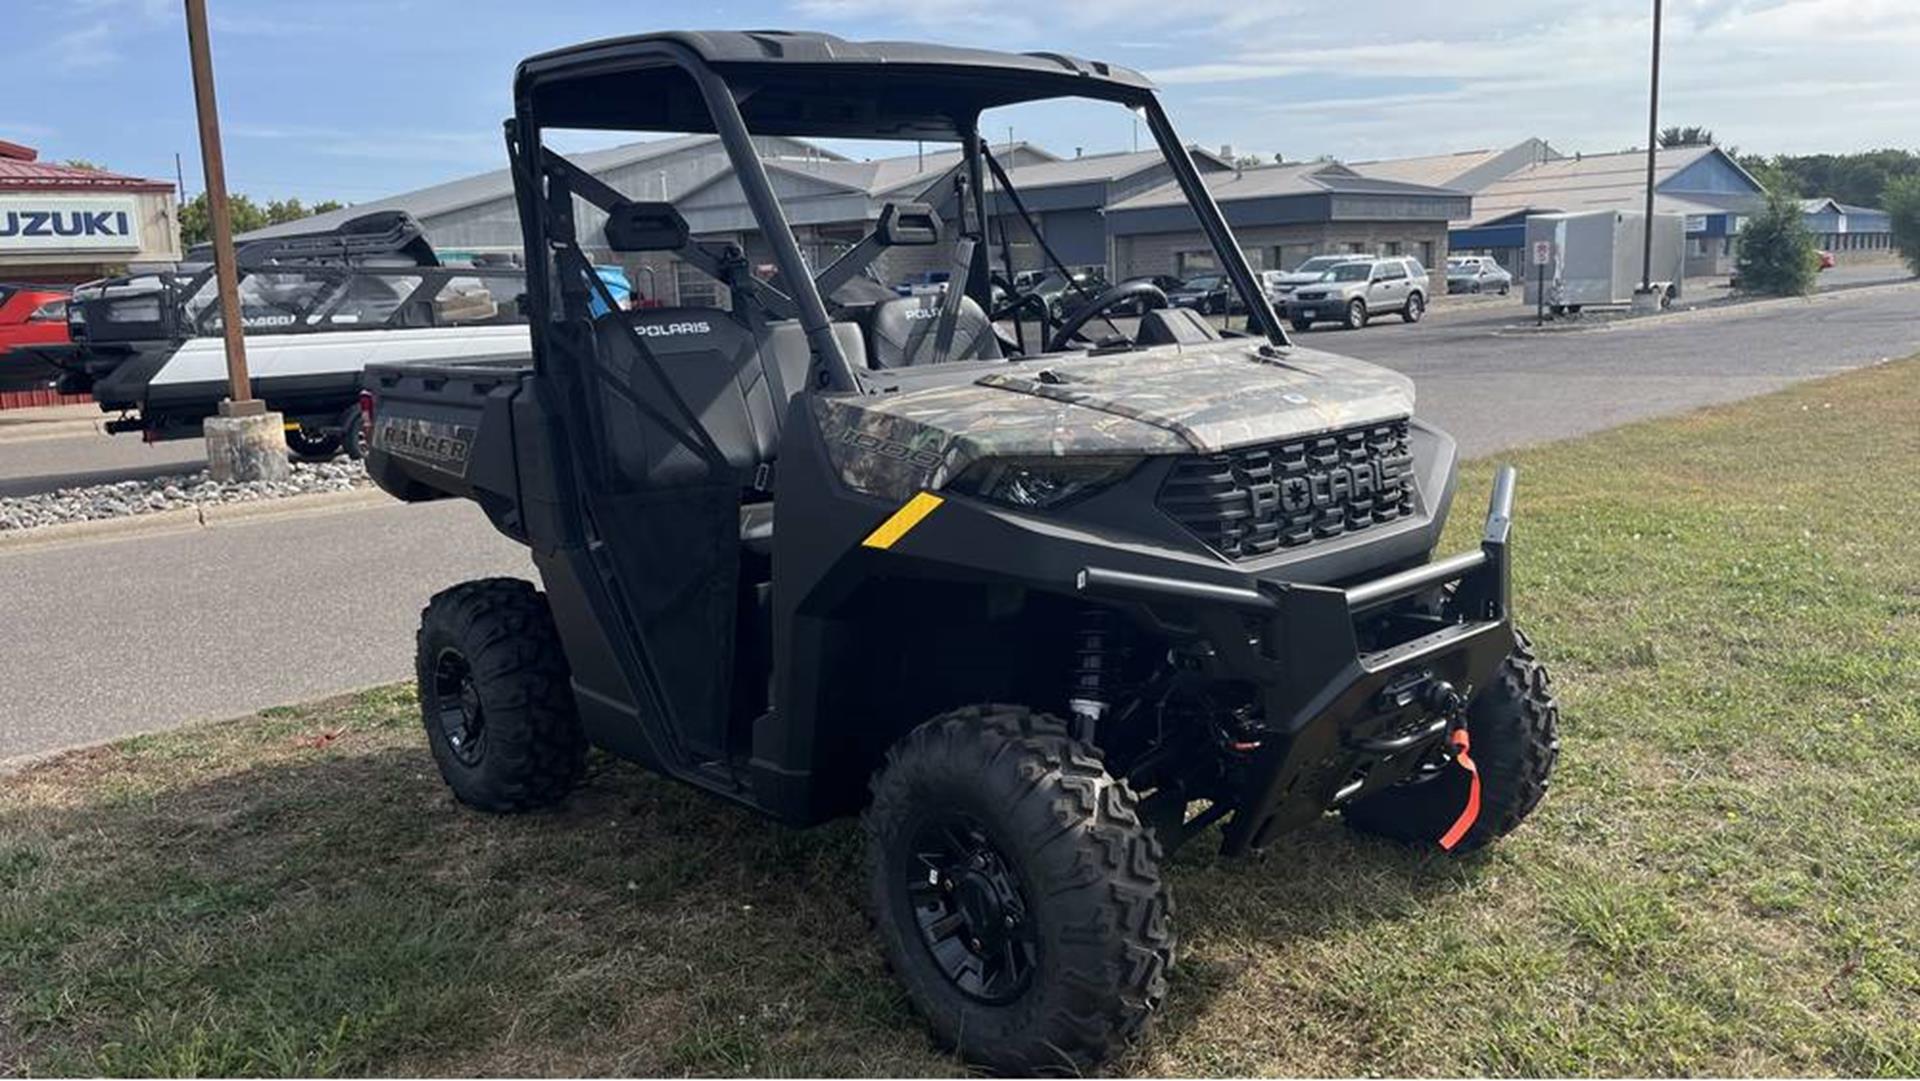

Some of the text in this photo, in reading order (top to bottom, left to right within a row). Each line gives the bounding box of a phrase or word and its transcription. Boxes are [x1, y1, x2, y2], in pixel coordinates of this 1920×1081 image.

[634, 321, 711, 337] POLARIS
[383, 426, 467, 460] RANGER
[1250, 455, 1402, 518] POLARIS
